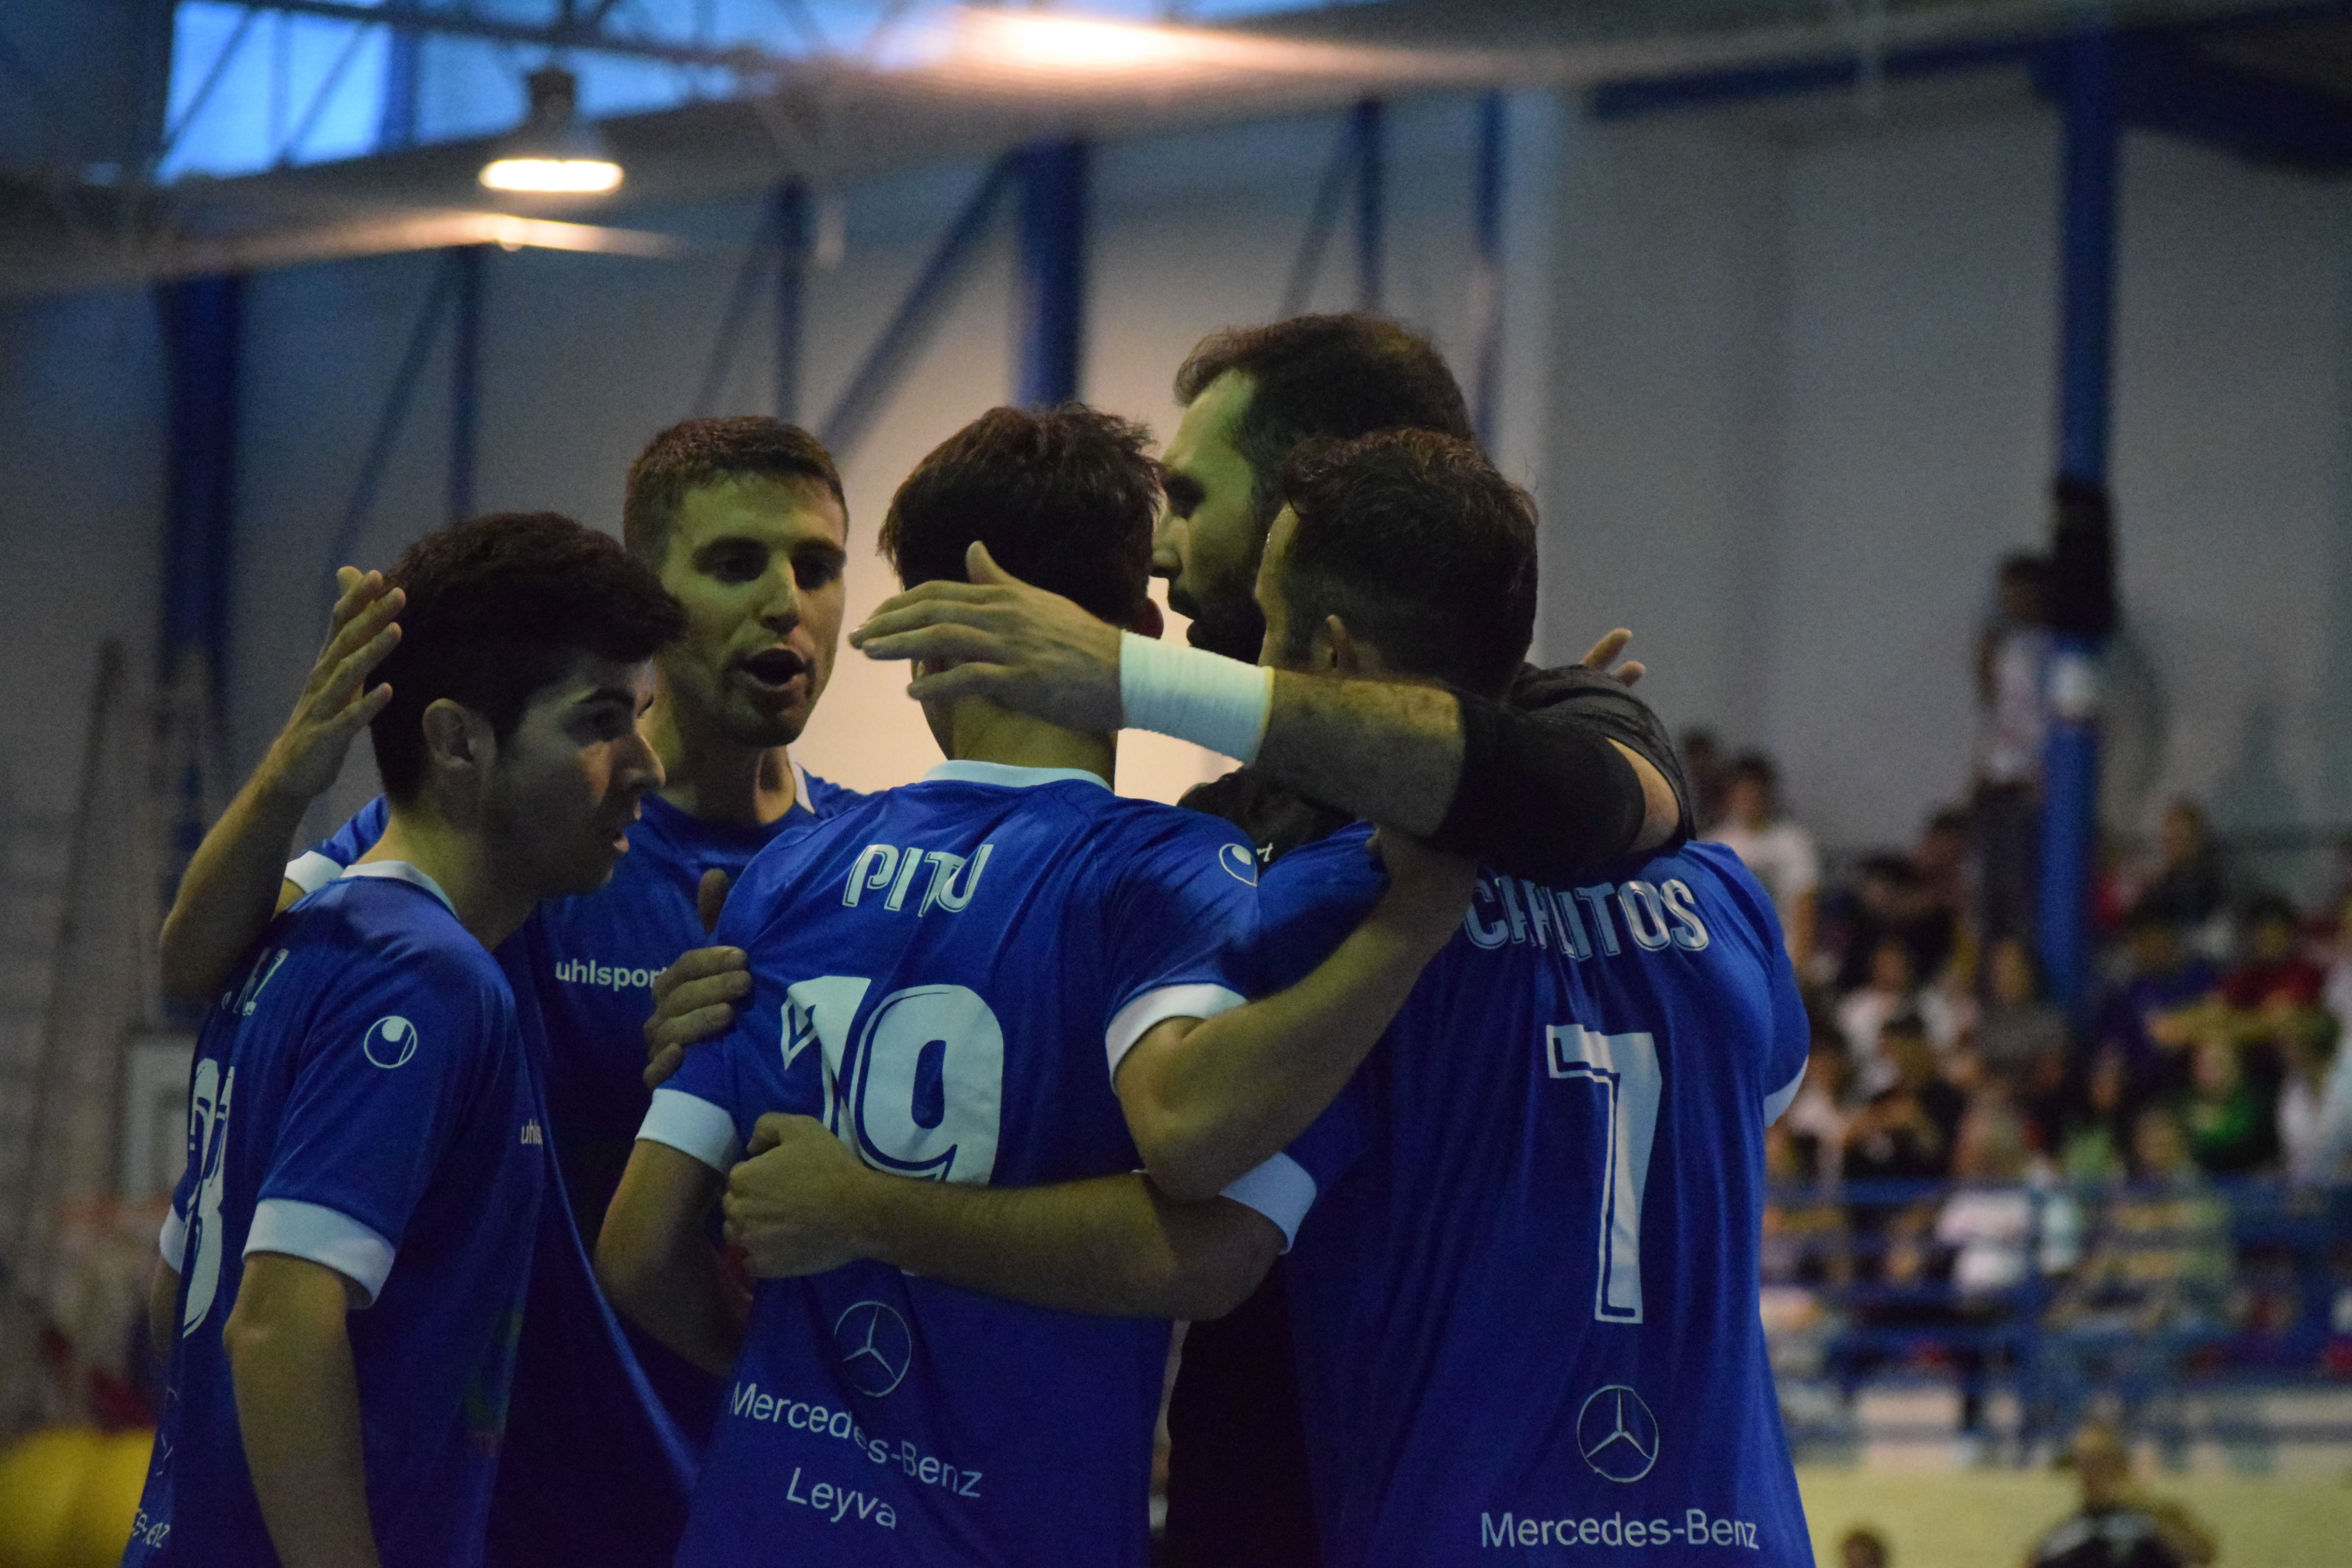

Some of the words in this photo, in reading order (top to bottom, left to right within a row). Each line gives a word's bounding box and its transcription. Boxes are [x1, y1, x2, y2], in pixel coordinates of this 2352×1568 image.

[841, 844, 994, 918] PITU
[555, 958, 667, 992] uhlspor
[780, 975, 1004, 1186] 19
[1545, 1025, 1663, 1324] 7
[730, 1381, 982, 1497] Mercedes-Benz
[786, 1467, 897, 1530] Leyva
[1481, 1508, 1760, 1550] Mercedes-Benz
